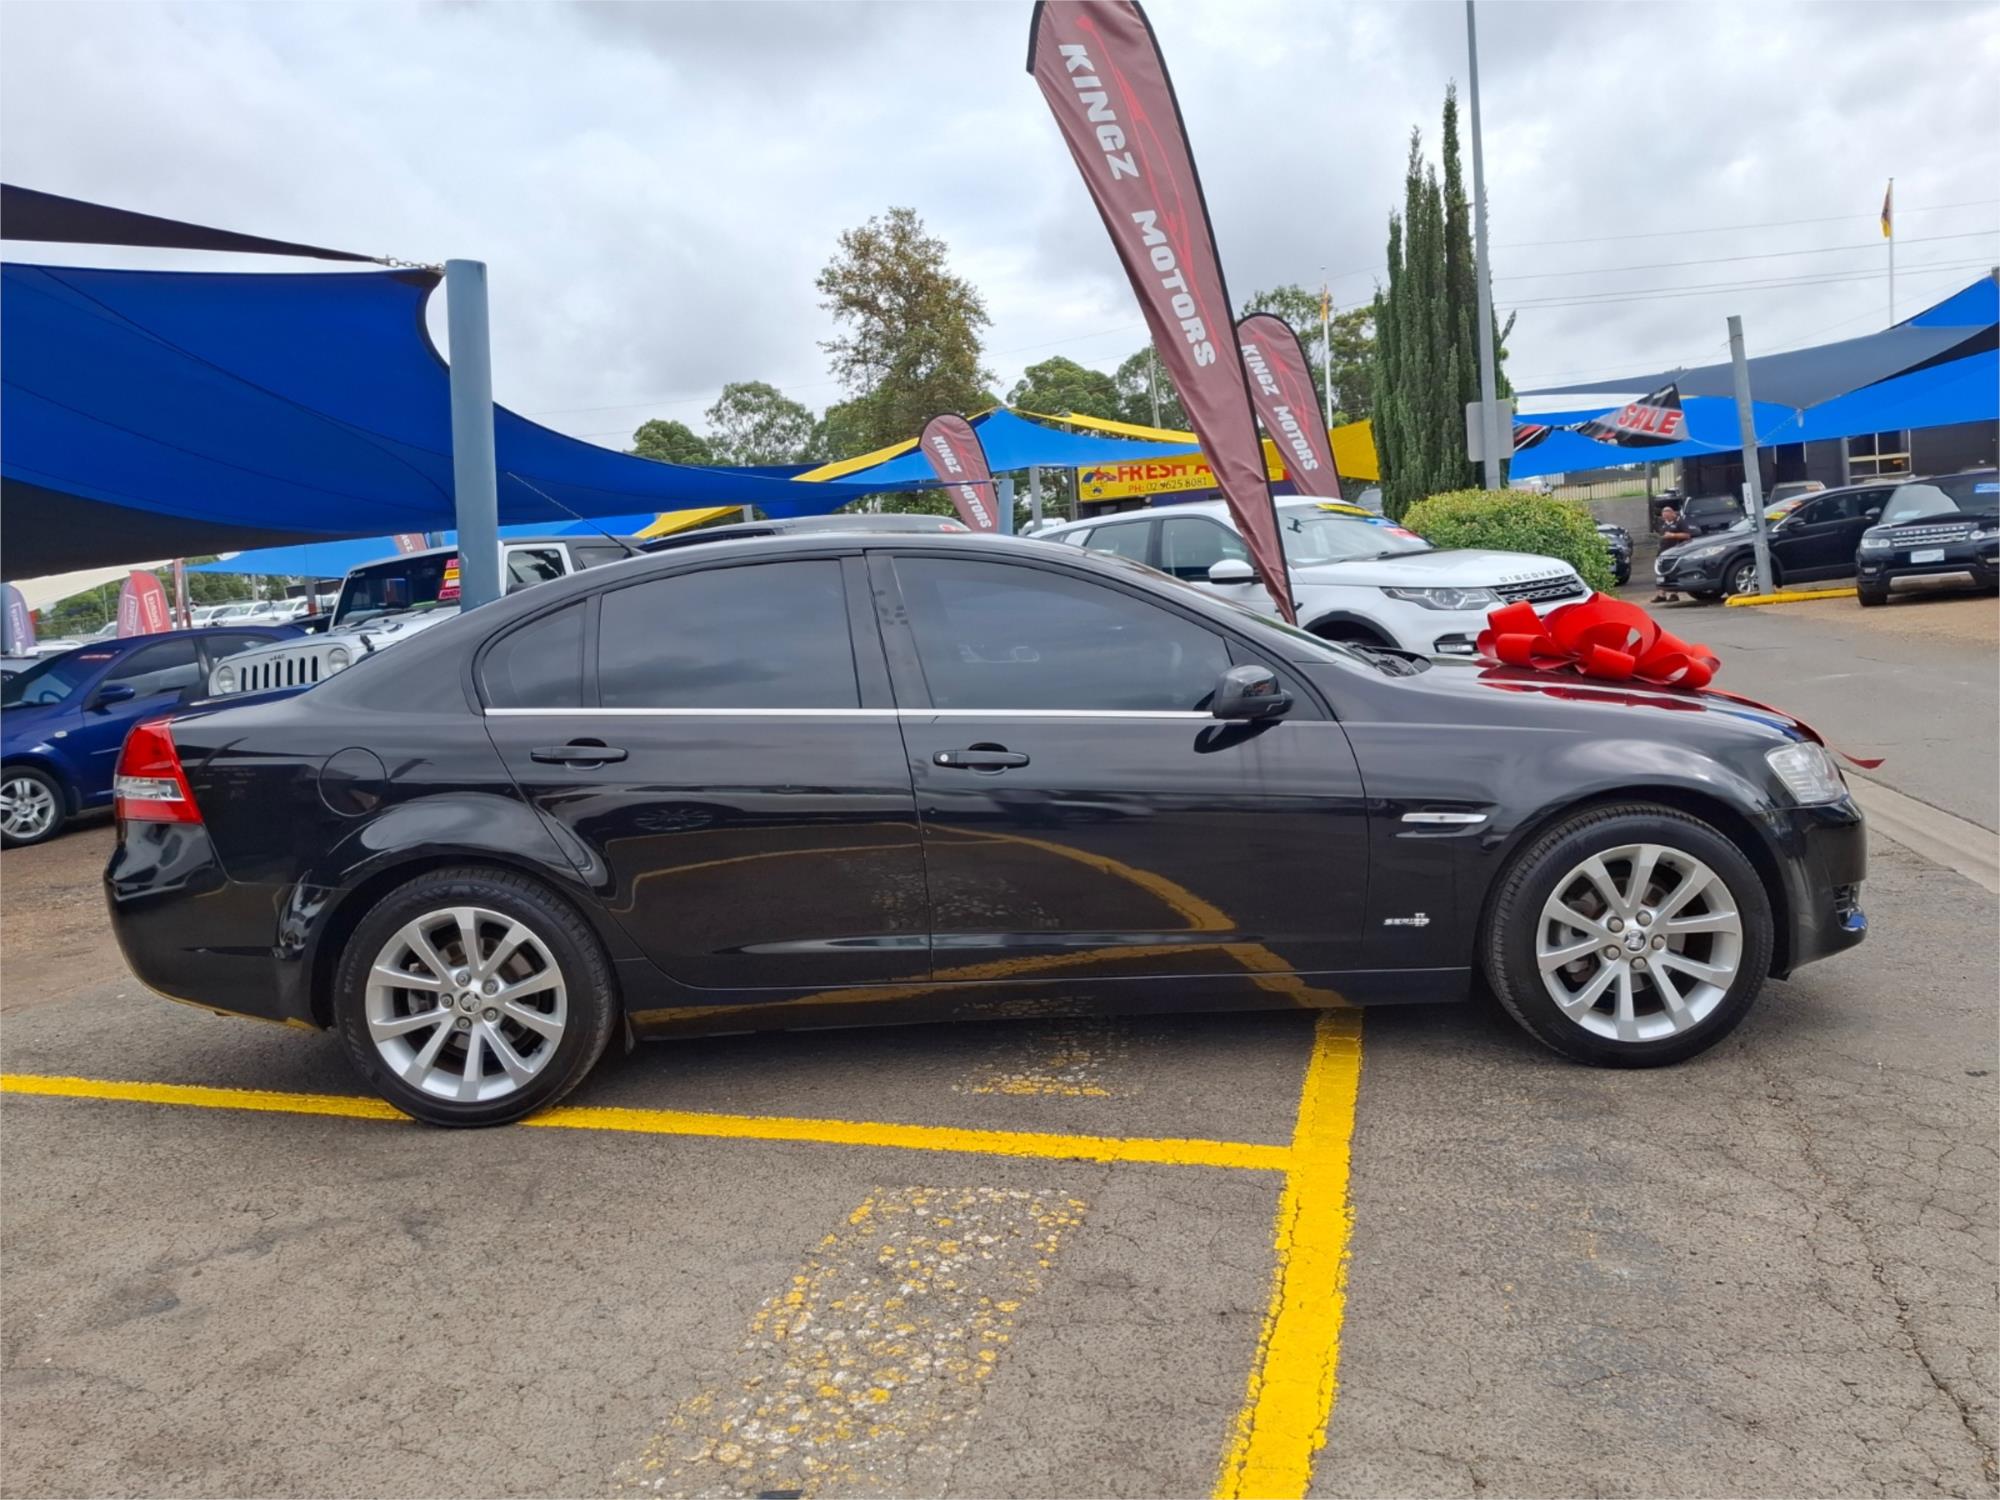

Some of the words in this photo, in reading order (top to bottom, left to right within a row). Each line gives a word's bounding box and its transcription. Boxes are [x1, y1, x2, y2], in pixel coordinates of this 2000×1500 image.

[1058, 44, 1139, 181] KINGZ
[1131, 209, 1216, 368] MOTORS
[1241, 344, 1280, 396] KINGZ
[1273, 405, 1318, 471] MOTORS
[1616, 404, 1684, 436] SALE
[931, 435, 962, 474] KINGZ
[959, 480, 992, 528] MOTORS
[1117, 464, 1186, 483] FRESH
